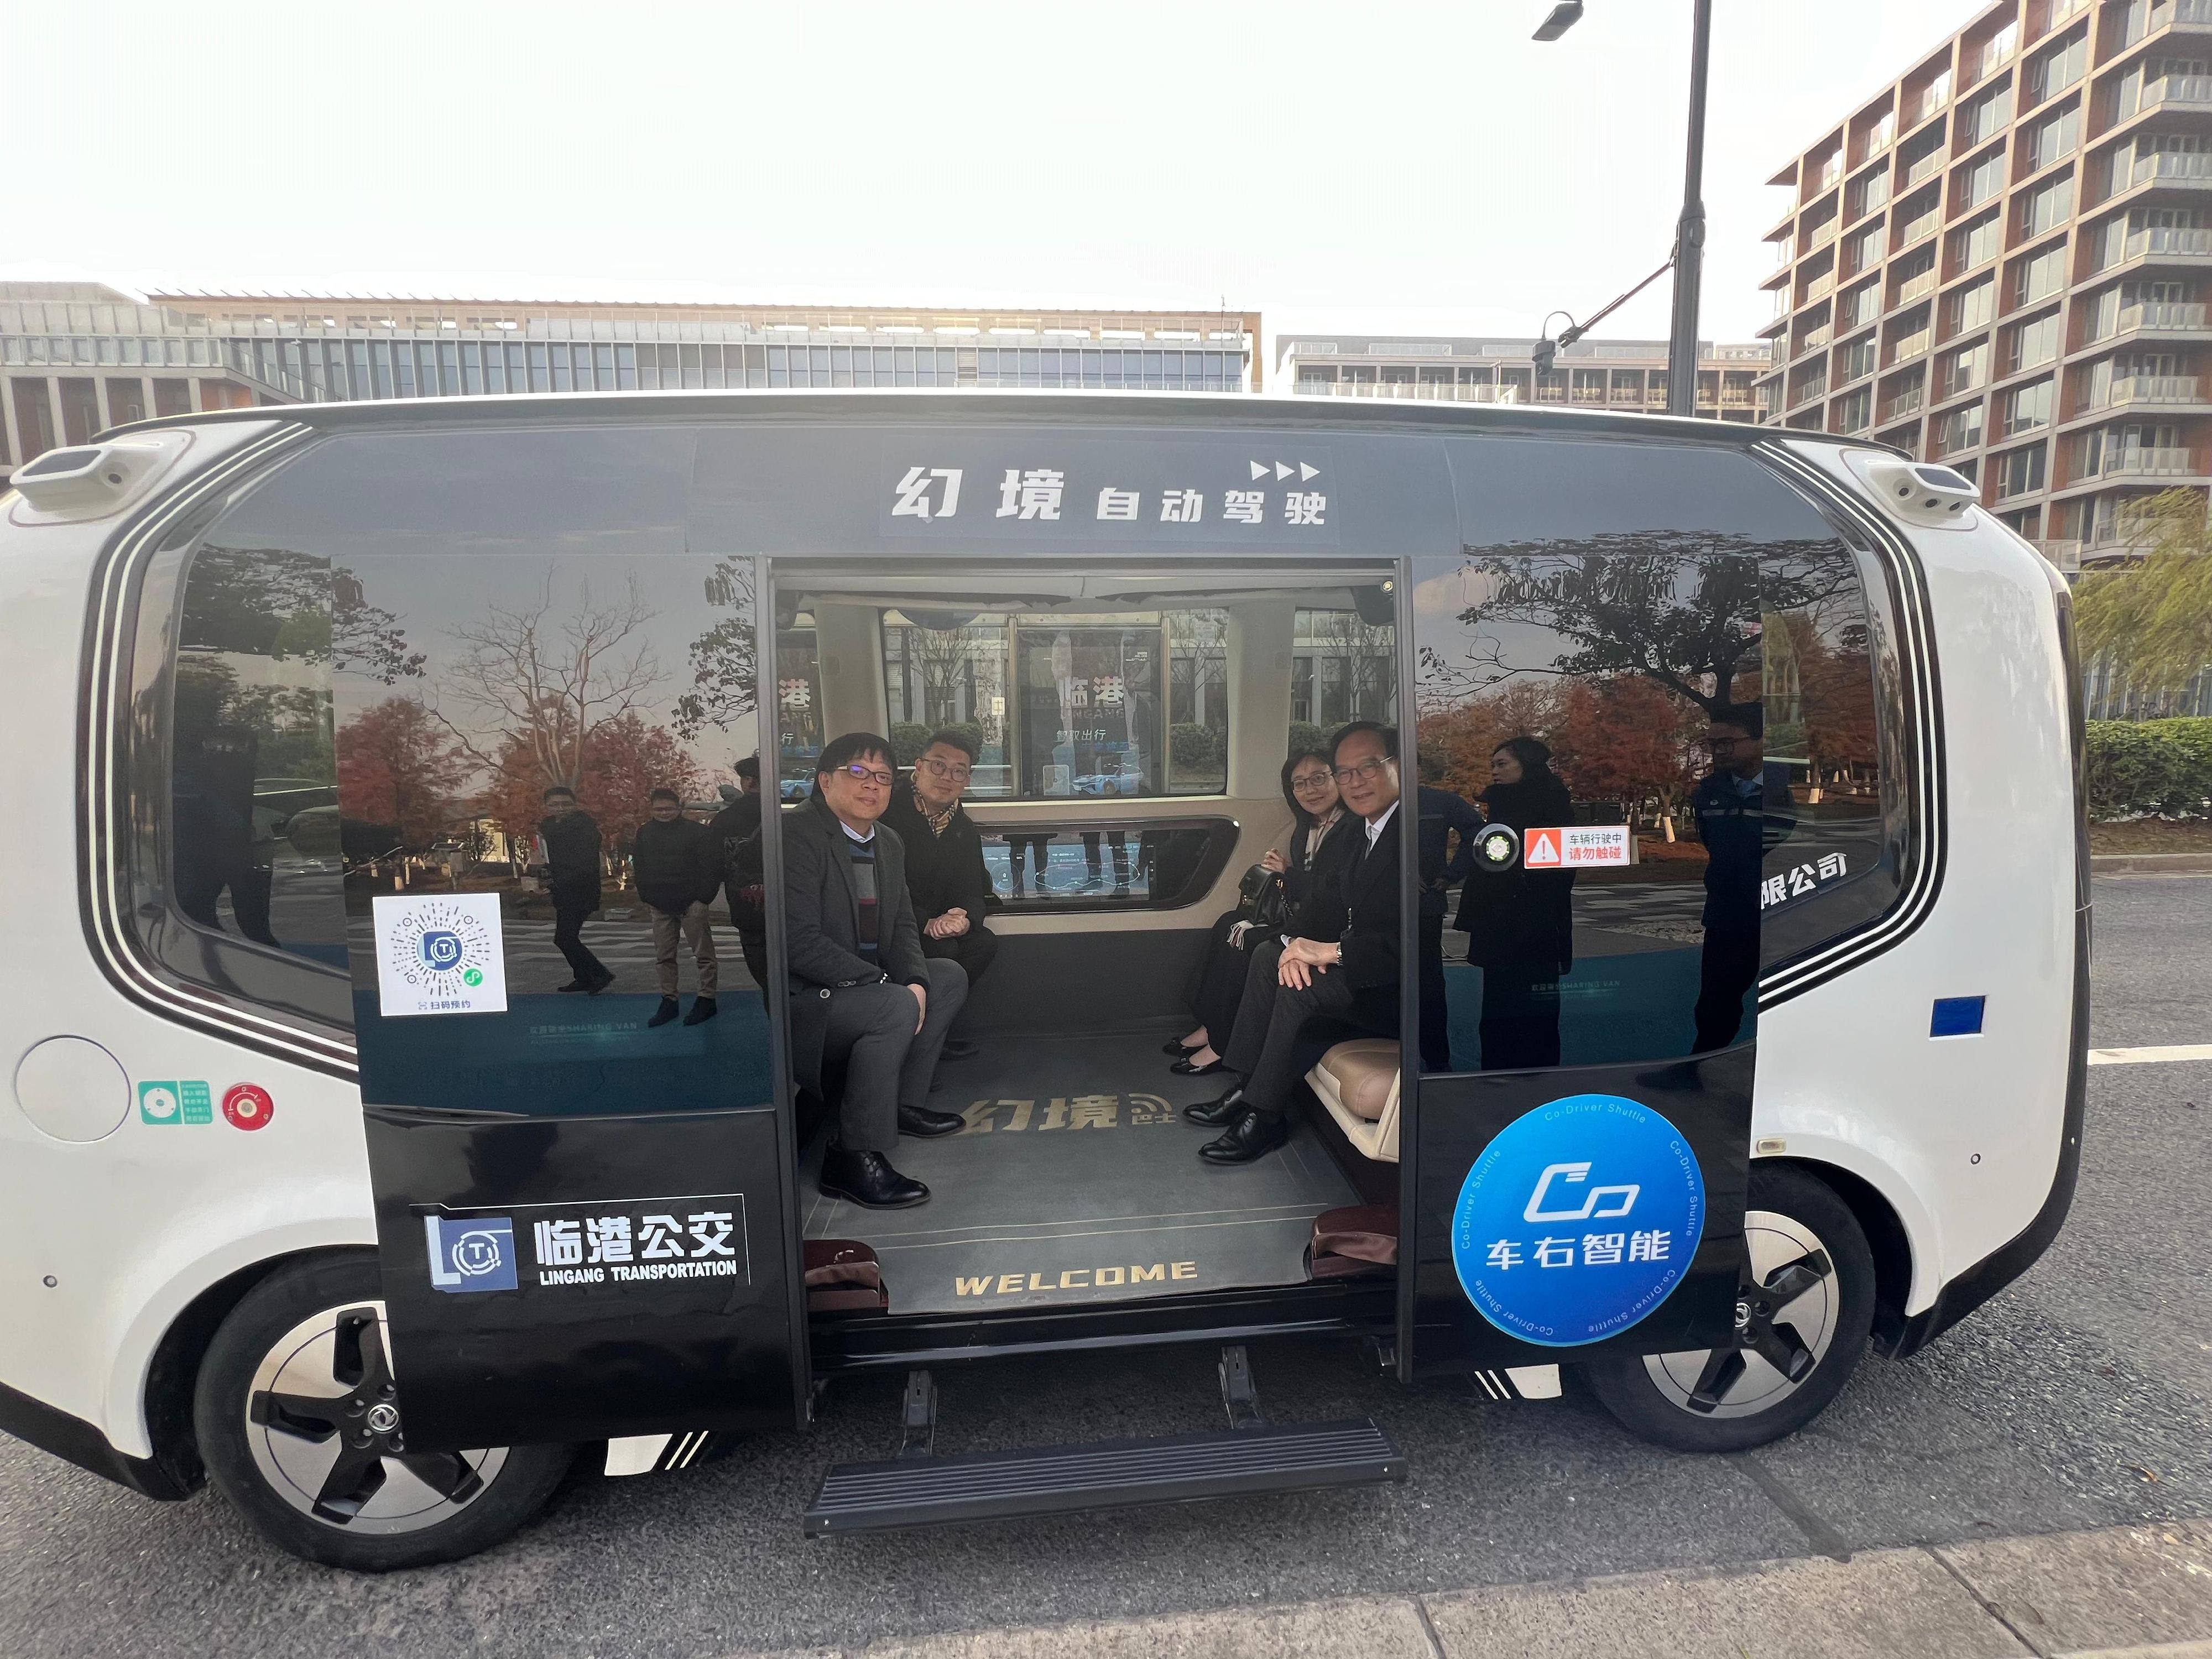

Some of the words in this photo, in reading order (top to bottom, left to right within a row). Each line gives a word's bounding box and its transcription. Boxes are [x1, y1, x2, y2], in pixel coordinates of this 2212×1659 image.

[892, 467, 1065, 521] 幻境
[1097, 487, 1327, 525] 自动驾驶
[779, 679, 811, 711] 港
[1058, 676, 1125, 708] 临港
[1569, 832, 1622, 844] 车辆行驶中
[1569, 846, 1622, 860] 请勿触碰
[430, 1000, 471, 1010] 扫码预约
[1132, 1113, 1176, 1125] 巴士
[1545, 1104, 1603, 1121] Co-Driver
[1608, 1104, 1646, 1124] Shuttle
[1462, 1192, 1475, 1250] Co-Driver
[1473, 1150, 1501, 1188] Shuttle
[1670, 1140, 1695, 1192] Co-Driver
[1686, 1196, 1698, 1237] Shuttle
[534, 1211, 735, 1266] 临港公交
[1486, 1229, 1671, 1270] 车右智能
[540, 1270, 605, 1286] LINGANG
[610, 1260, 737, 1282] TRANSPORTATION
[955, 1261, 1198, 1296] WELCOME
[1475, 1280, 1503, 1313] Shuttle
[1631, 1269, 1676, 1313] Co-Driver
[1503, 1310, 1553, 1336] Co-Driver
[1588, 1312, 1629, 1333] Shuttle
